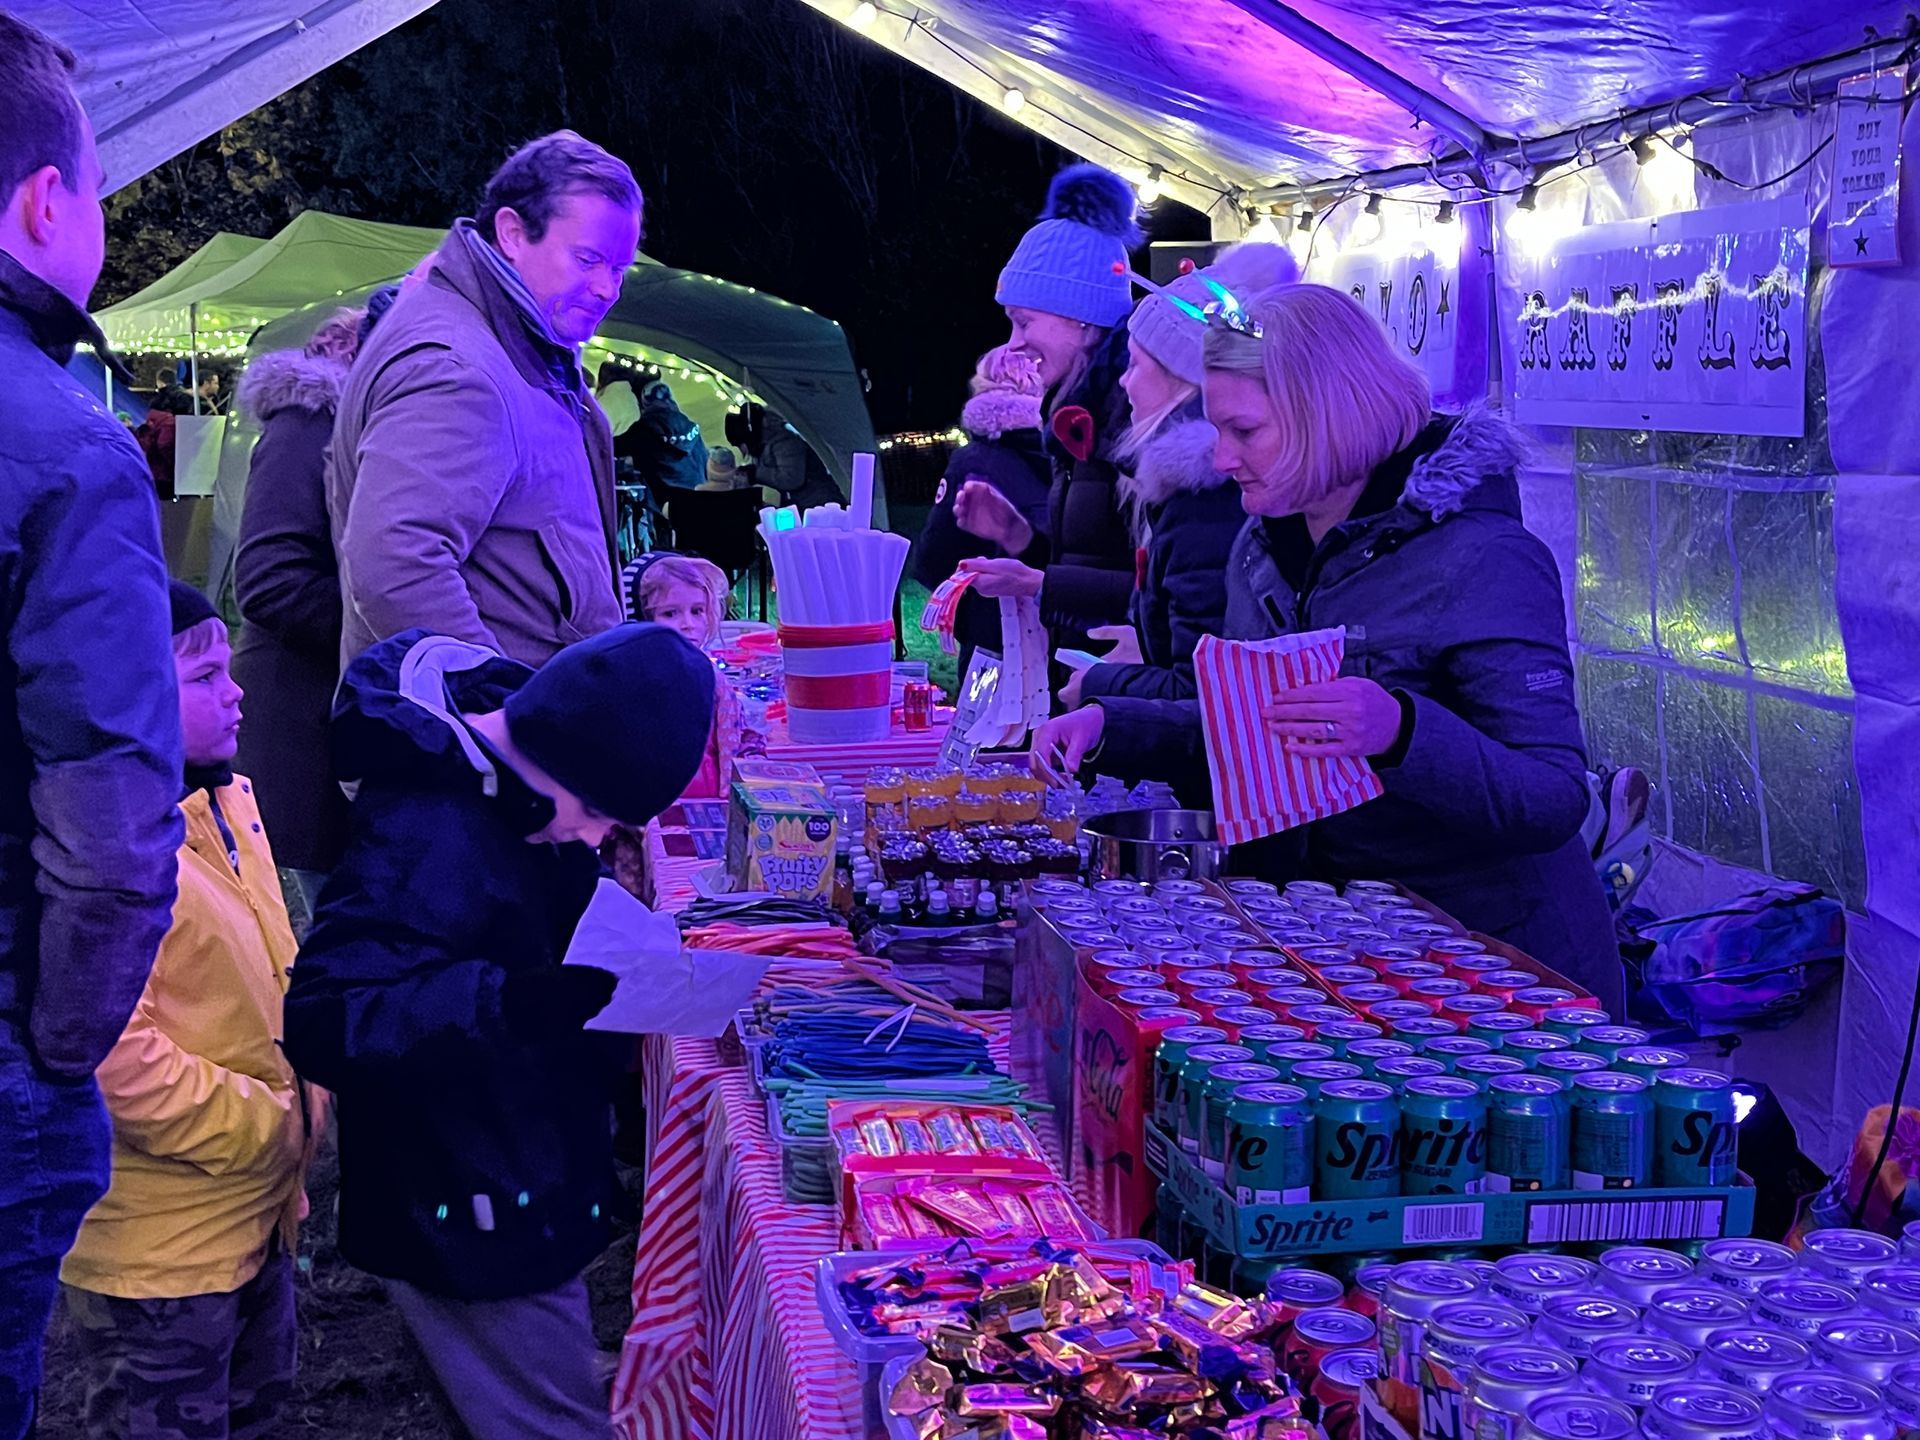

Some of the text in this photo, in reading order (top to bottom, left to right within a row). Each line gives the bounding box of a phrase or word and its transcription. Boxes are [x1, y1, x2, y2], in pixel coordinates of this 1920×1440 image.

[1856, 120, 1882, 141] BUY
[1852, 147, 1882, 167] YOUR
[1519, 272, 1792, 371] RAFFLE
[808, 822, 830, 832] 100
[1248, 1210, 1353, 1252] Sprite
[1627, 1382, 1661, 1396] zer
